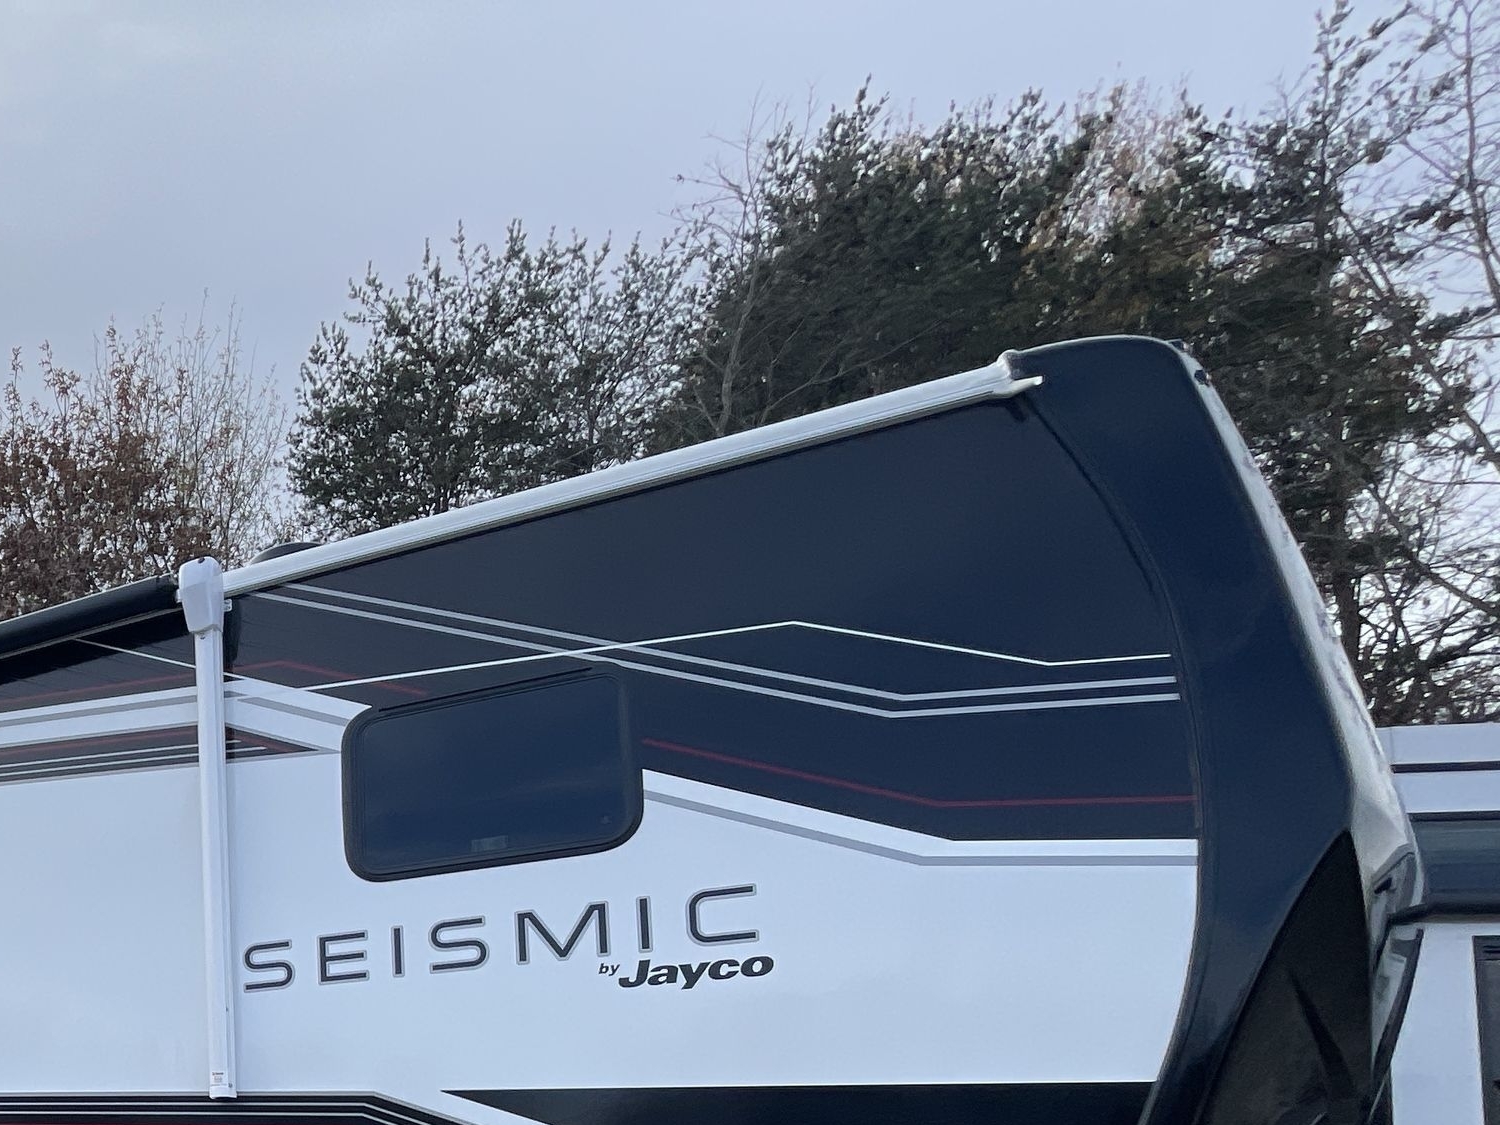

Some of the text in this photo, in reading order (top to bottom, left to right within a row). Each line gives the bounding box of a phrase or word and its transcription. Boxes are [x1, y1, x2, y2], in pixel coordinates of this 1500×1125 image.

[243, 883, 760, 993] SEISMIC
[598, 955, 774, 990] by Jayco
